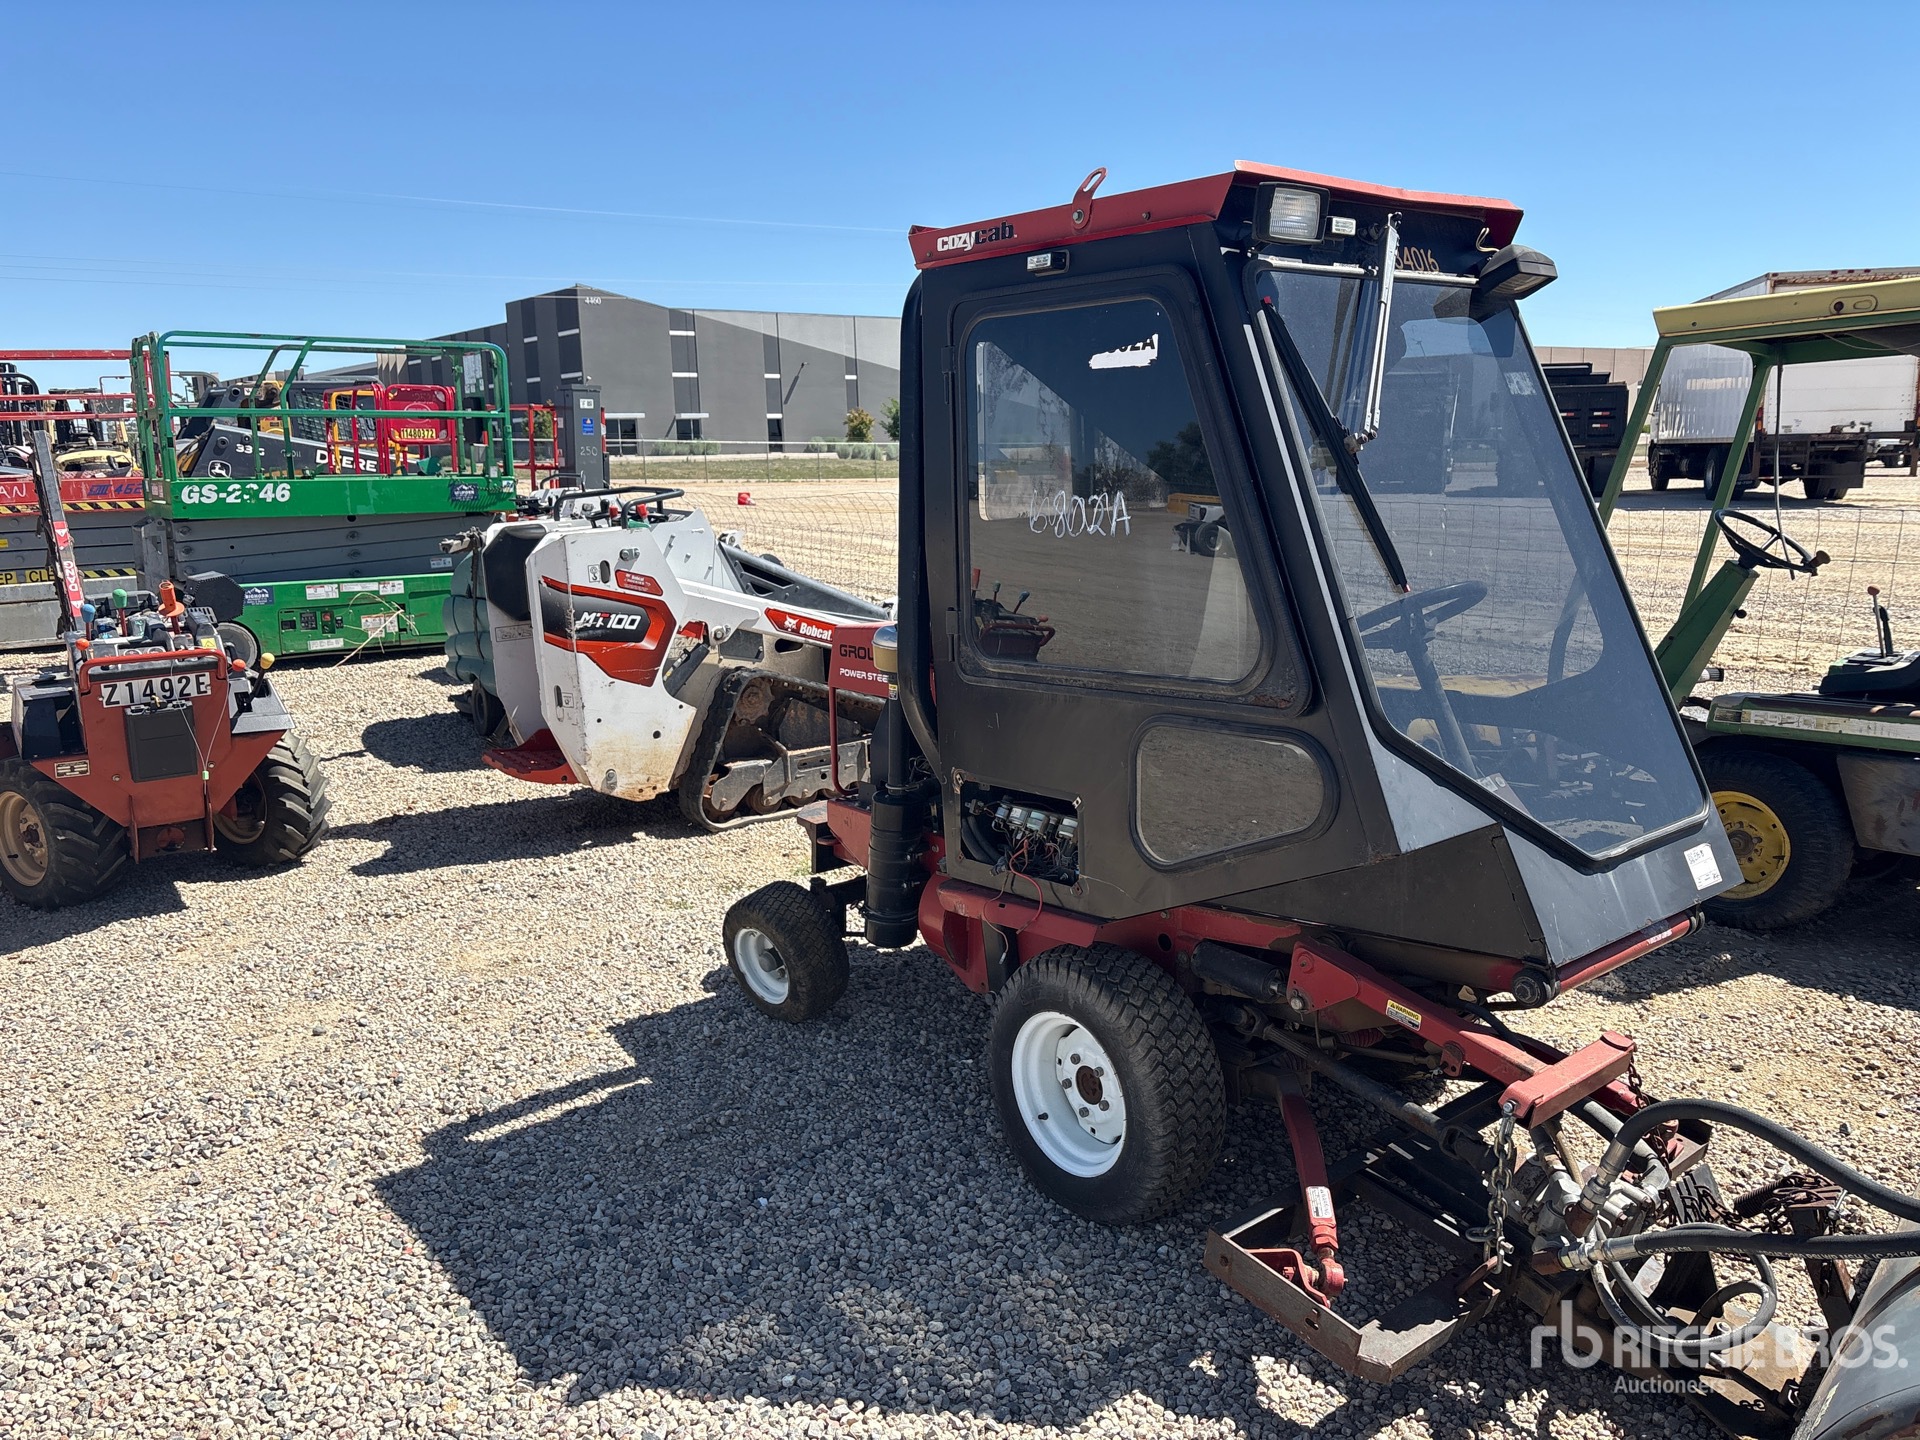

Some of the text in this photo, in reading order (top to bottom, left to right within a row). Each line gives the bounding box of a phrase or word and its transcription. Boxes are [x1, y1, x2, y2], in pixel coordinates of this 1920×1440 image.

[235, 443, 265, 456] 33G
[580, 445, 598, 457] 250
[799, 622, 832, 641] Bobcat
[839, 667, 868, 681] POWER
[103, 673, 208, 707] Z1492E
[1395, 1004, 1420, 1021] WARNING
